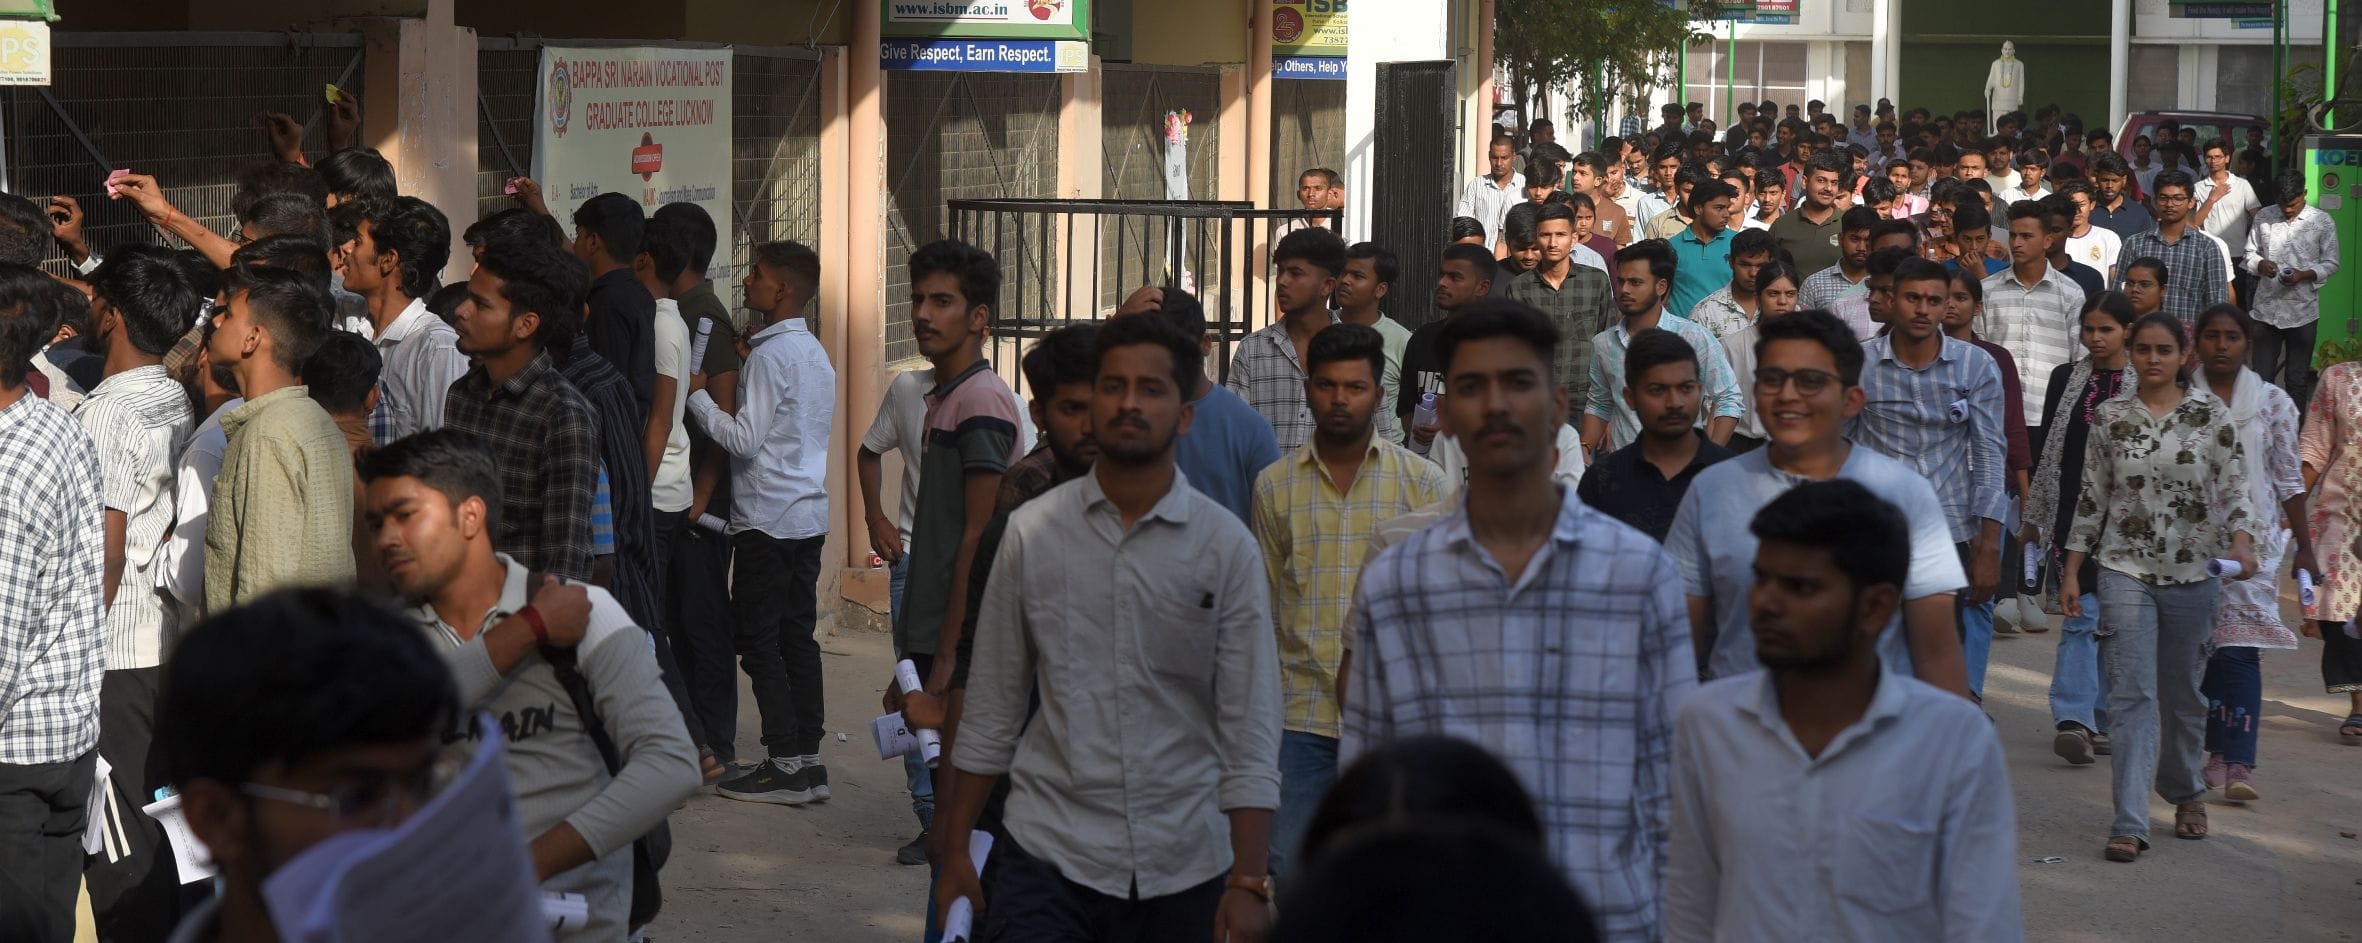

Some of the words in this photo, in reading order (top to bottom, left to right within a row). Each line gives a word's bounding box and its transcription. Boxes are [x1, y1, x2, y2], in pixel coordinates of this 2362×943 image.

[896, 2, 1008, 15] www.isbm.ac.in
[881, 43, 907, 59] Give
[911, 44, 963, 63] Respect,
[967, 45, 995, 61] Earn
[999, 45, 1052, 65] Respect.
[572, 61, 602, 88] BAPPA
[604, 61, 619, 88] SRI
[621, 60, 652, 87] NARAIN
[655, 60, 704, 86] VOCATIONAL
[705, 60, 725, 87] POST
[1285, 60, 1317, 74] Others,
[1318, 61, 1339, 75] Help
[586, 101, 634, 130] GRADUATE
[636, 100, 674, 128] COLLEGE
[676, 99, 714, 125] LUCKNOW
